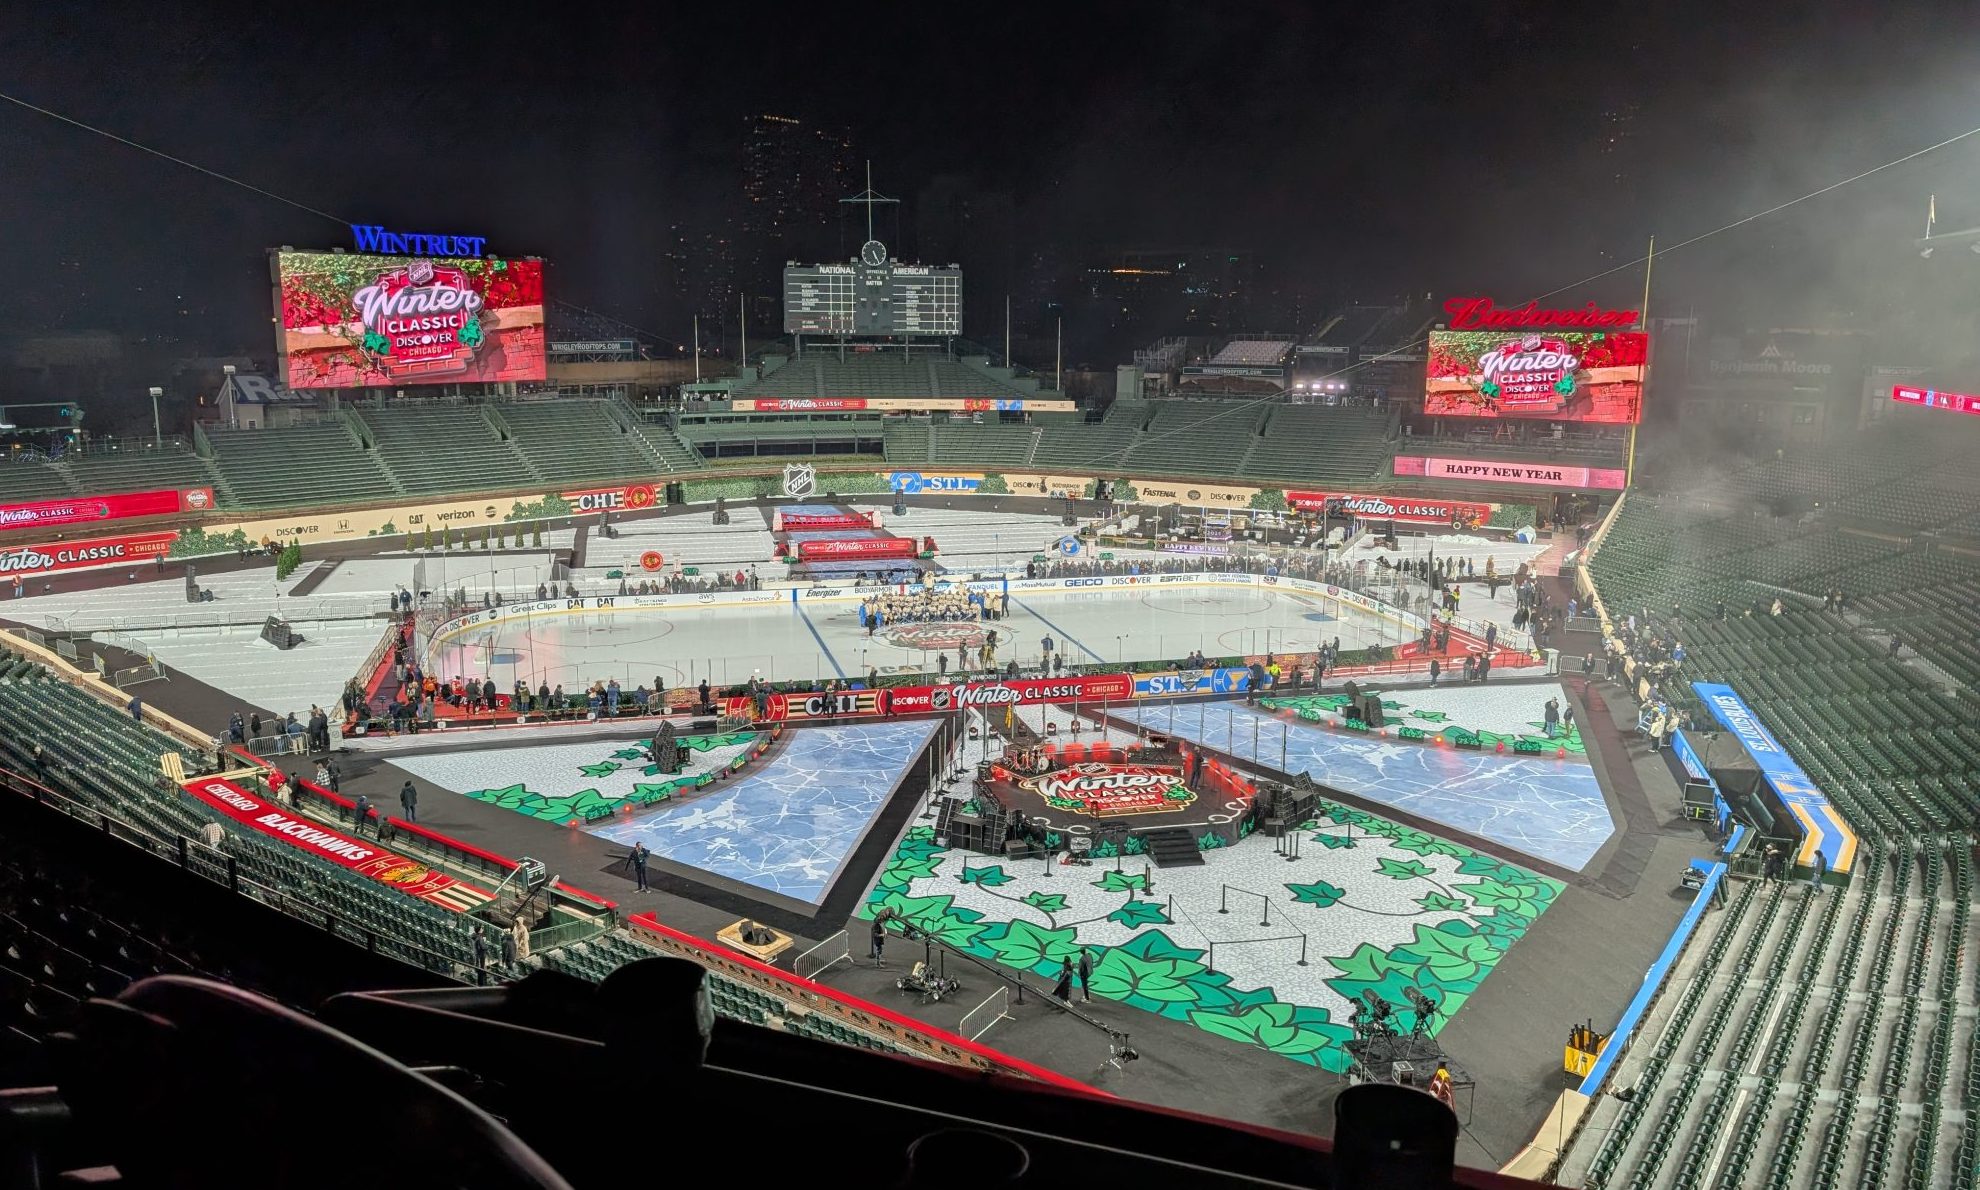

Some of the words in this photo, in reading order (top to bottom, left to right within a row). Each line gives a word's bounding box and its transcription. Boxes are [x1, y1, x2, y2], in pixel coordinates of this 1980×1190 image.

[413, 264, 428, 281] NHL
[819, 266, 856, 274] NATIONAL
[893, 267, 928, 275] AMERICAN
[354, 281, 482, 328] Winter
[1444, 298, 1639, 329] Budweiser
[388, 316, 460, 334] CLASSIC
[396, 332, 453, 348] DISCOVER
[409, 346, 442, 357] CHICAGO
[1479, 351, 1578, 379] Winter
[1782, 361, 1832, 374] Moore
[1500, 371, 1556, 384] CLASSIC
[1505, 384, 1550, 394] DISCOVER
[787, 399, 818, 410] Winter
[1446, 464, 1488, 476] HAPPY
[1492, 467, 1523, 478] NEW
[1526, 469, 1563, 482] YEAR
[791, 469, 812, 493] NHL
[930, 477, 970, 490] STL
[578, 492, 617, 510] CHI
[1210, 492, 1246, 502] DISCOVER
[40, 508, 74, 518] CLASSIC
[436, 510, 476, 521] verizon
[1398, 504, 1448, 517] CLASSIC
[408, 514, 424, 524] CAT
[276, 525, 320, 536] DISCOVER
[0, 548, 54, 572] inter
[57, 545, 125, 564] CLASSIC
[135, 542, 166, 552] CHICAGO
[1065, 578, 1103, 588] GEICO
[1112, 576, 1151, 585] DISCOVER
[806, 588, 842, 598] Energizer
[854, 586, 892, 594] BODYARMOR
[511, 606, 536, 614] Great
[536, 602, 558, 612] Clips
[567, 599, 586, 610] CAT
[597, 597, 615, 608] CAT
[450, 614, 480, 632] DISCOVER
[892, 696, 929, 706] ISCOVER
[953, 684, 1022, 708] Winter
[1025, 685, 1082, 698] CLASSIC
[1092, 684, 1119, 694] CHICAGO
[1038, 773, 1179, 797] Winter
[1075, 787, 1160, 800] CLASSIC
[205, 784, 260, 812] CHICAGO
[255, 813, 375, 861] BLACKHAWKS
